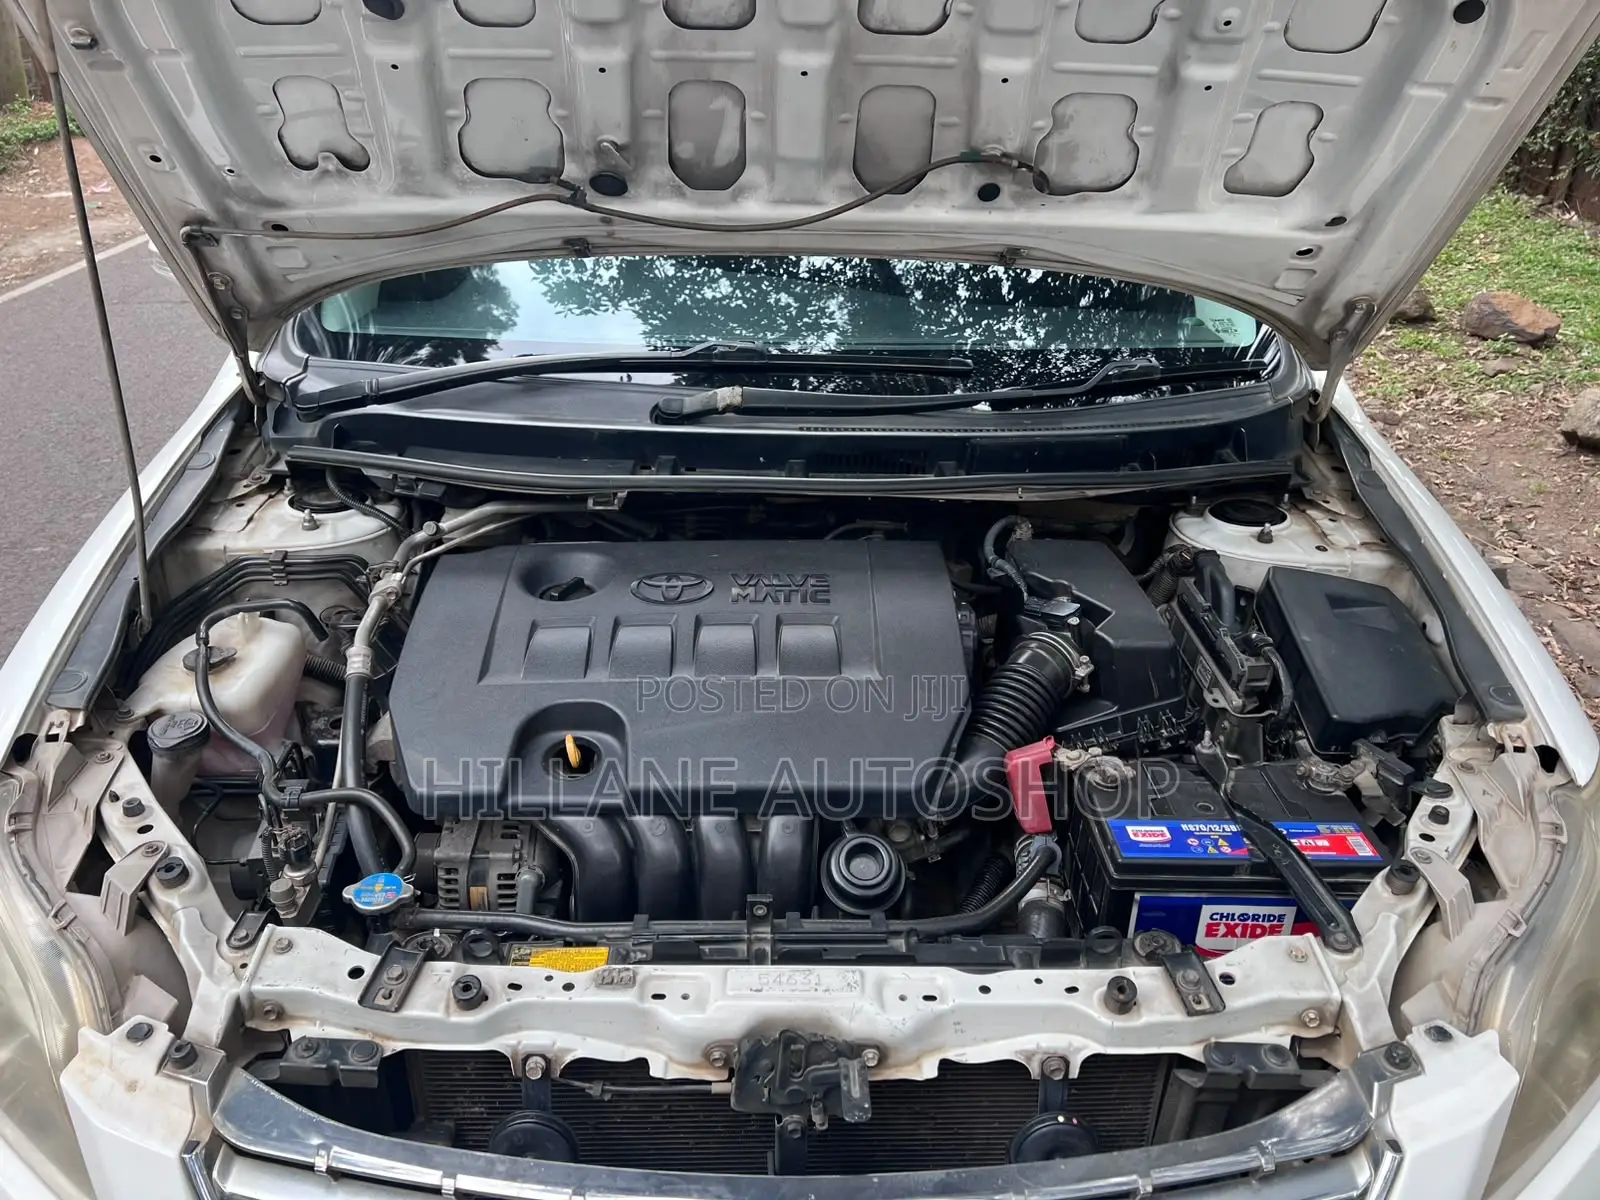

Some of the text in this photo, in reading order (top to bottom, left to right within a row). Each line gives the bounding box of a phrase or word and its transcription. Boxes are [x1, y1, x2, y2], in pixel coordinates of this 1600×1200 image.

[730, 573, 830, 588] VALVE
[730, 587, 831, 605] MATIC
[1209, 912, 1287, 923] CHLORIDE
[1204, 922, 1285, 939] EXIDE
